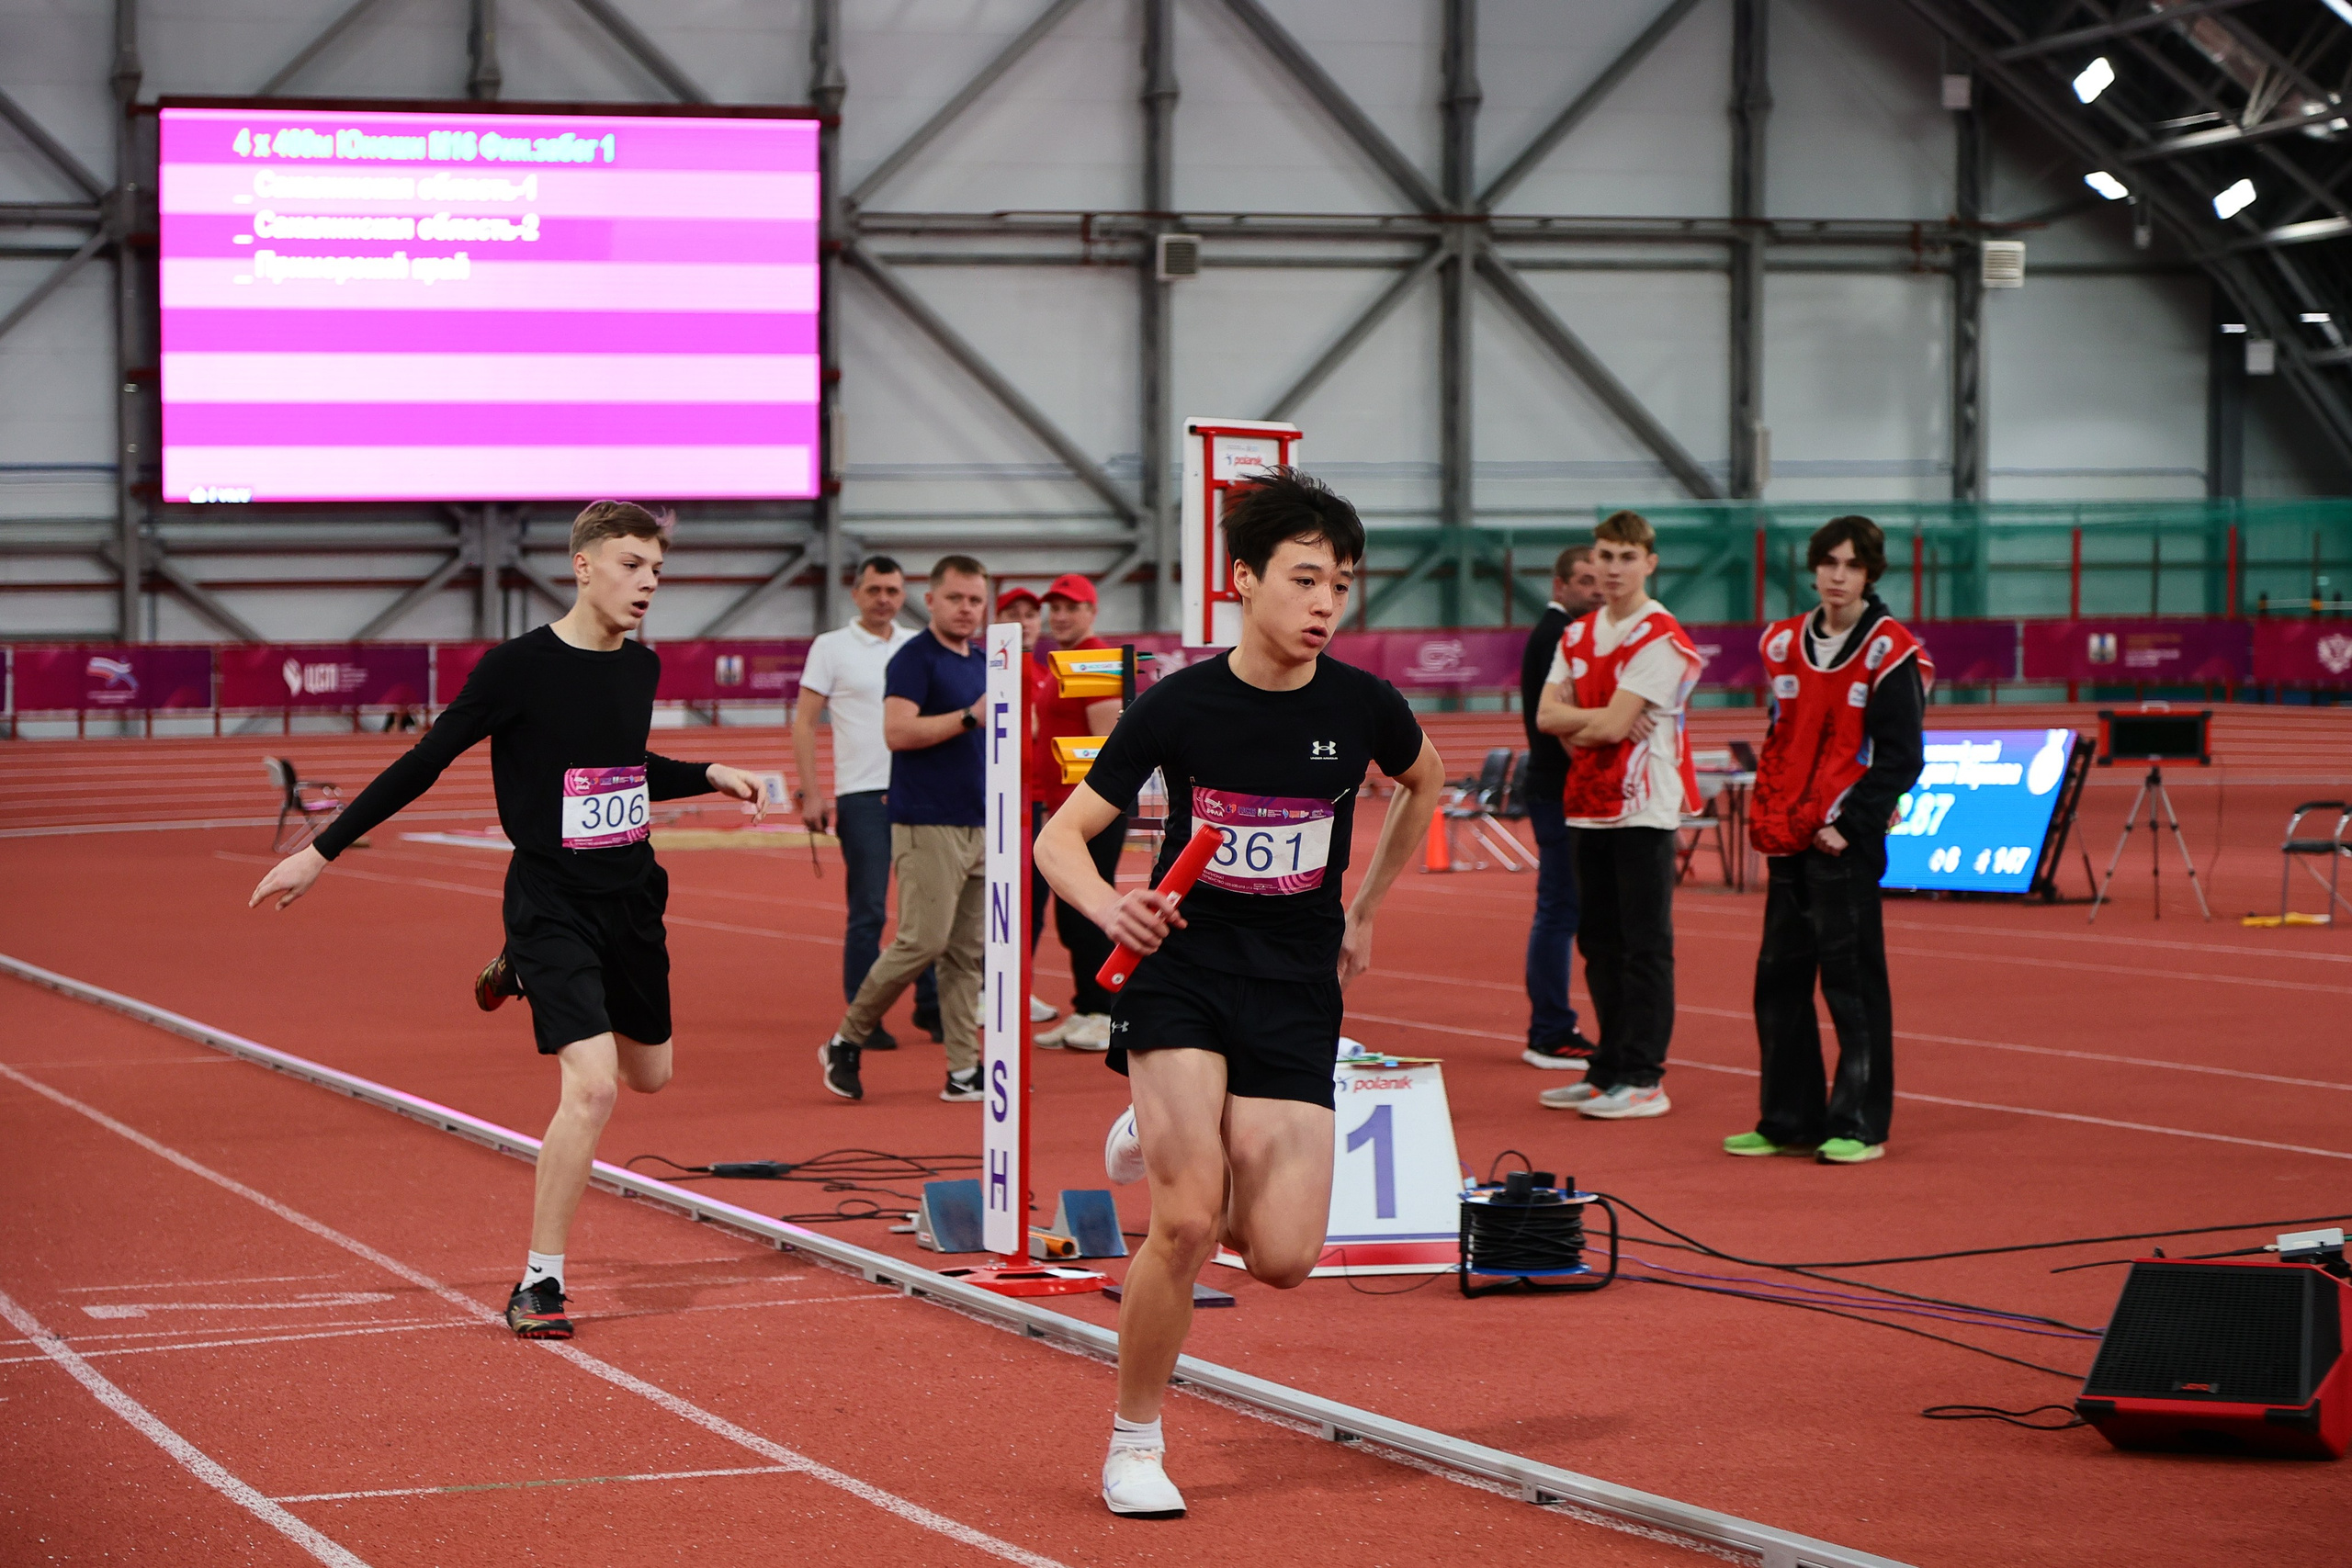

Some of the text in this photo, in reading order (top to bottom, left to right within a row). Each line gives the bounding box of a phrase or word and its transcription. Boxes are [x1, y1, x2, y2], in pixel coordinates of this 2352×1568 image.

[582, 794, 644, 829] 306
[1214, 827, 1302, 872] 361
[989, 703, 1009, 1212] FINISH
[1353, 1076, 1412, 1094] polanik
[1347, 1105, 1396, 1219] 1
